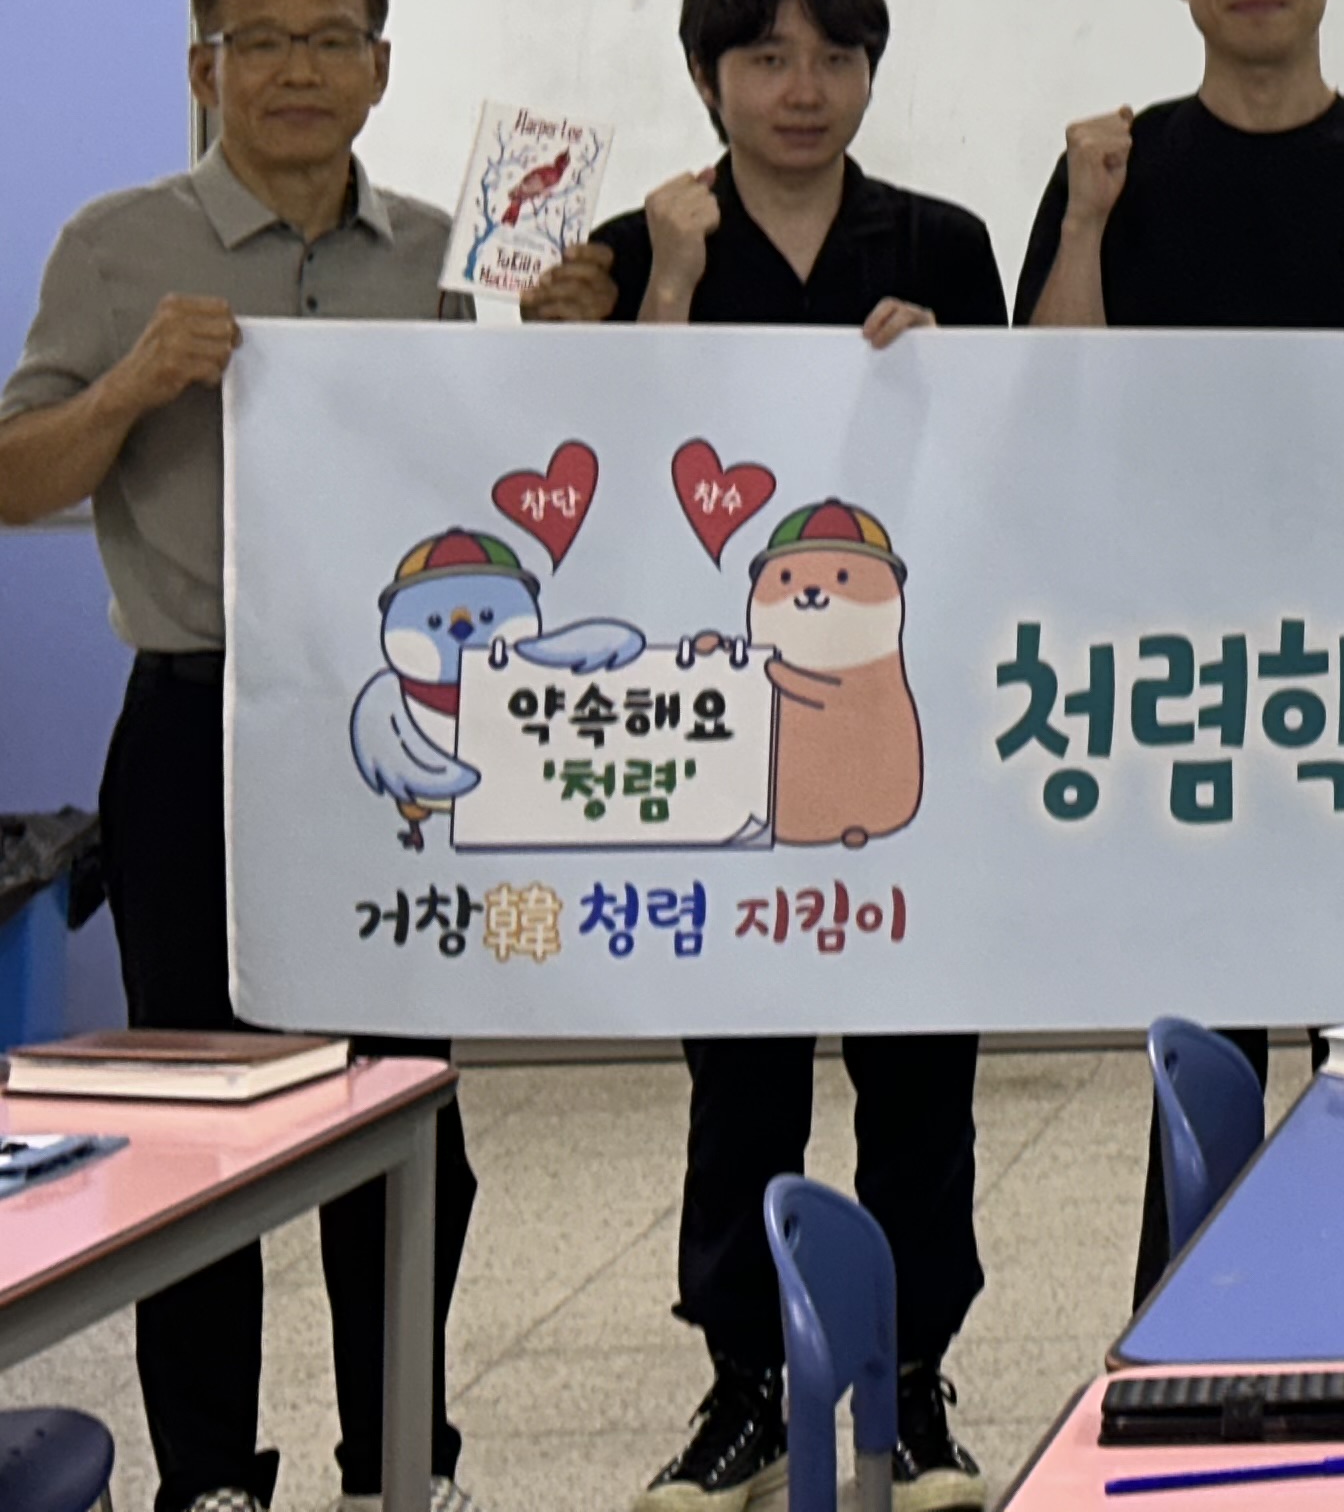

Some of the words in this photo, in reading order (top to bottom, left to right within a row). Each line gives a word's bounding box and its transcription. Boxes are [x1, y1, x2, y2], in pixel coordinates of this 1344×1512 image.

[508, 682, 734, 749] 약속해요
[542, 759, 697, 824] '청렴'
[578, 879, 707, 958] 청렴
[735, 879, 907, 954] 지킴이
